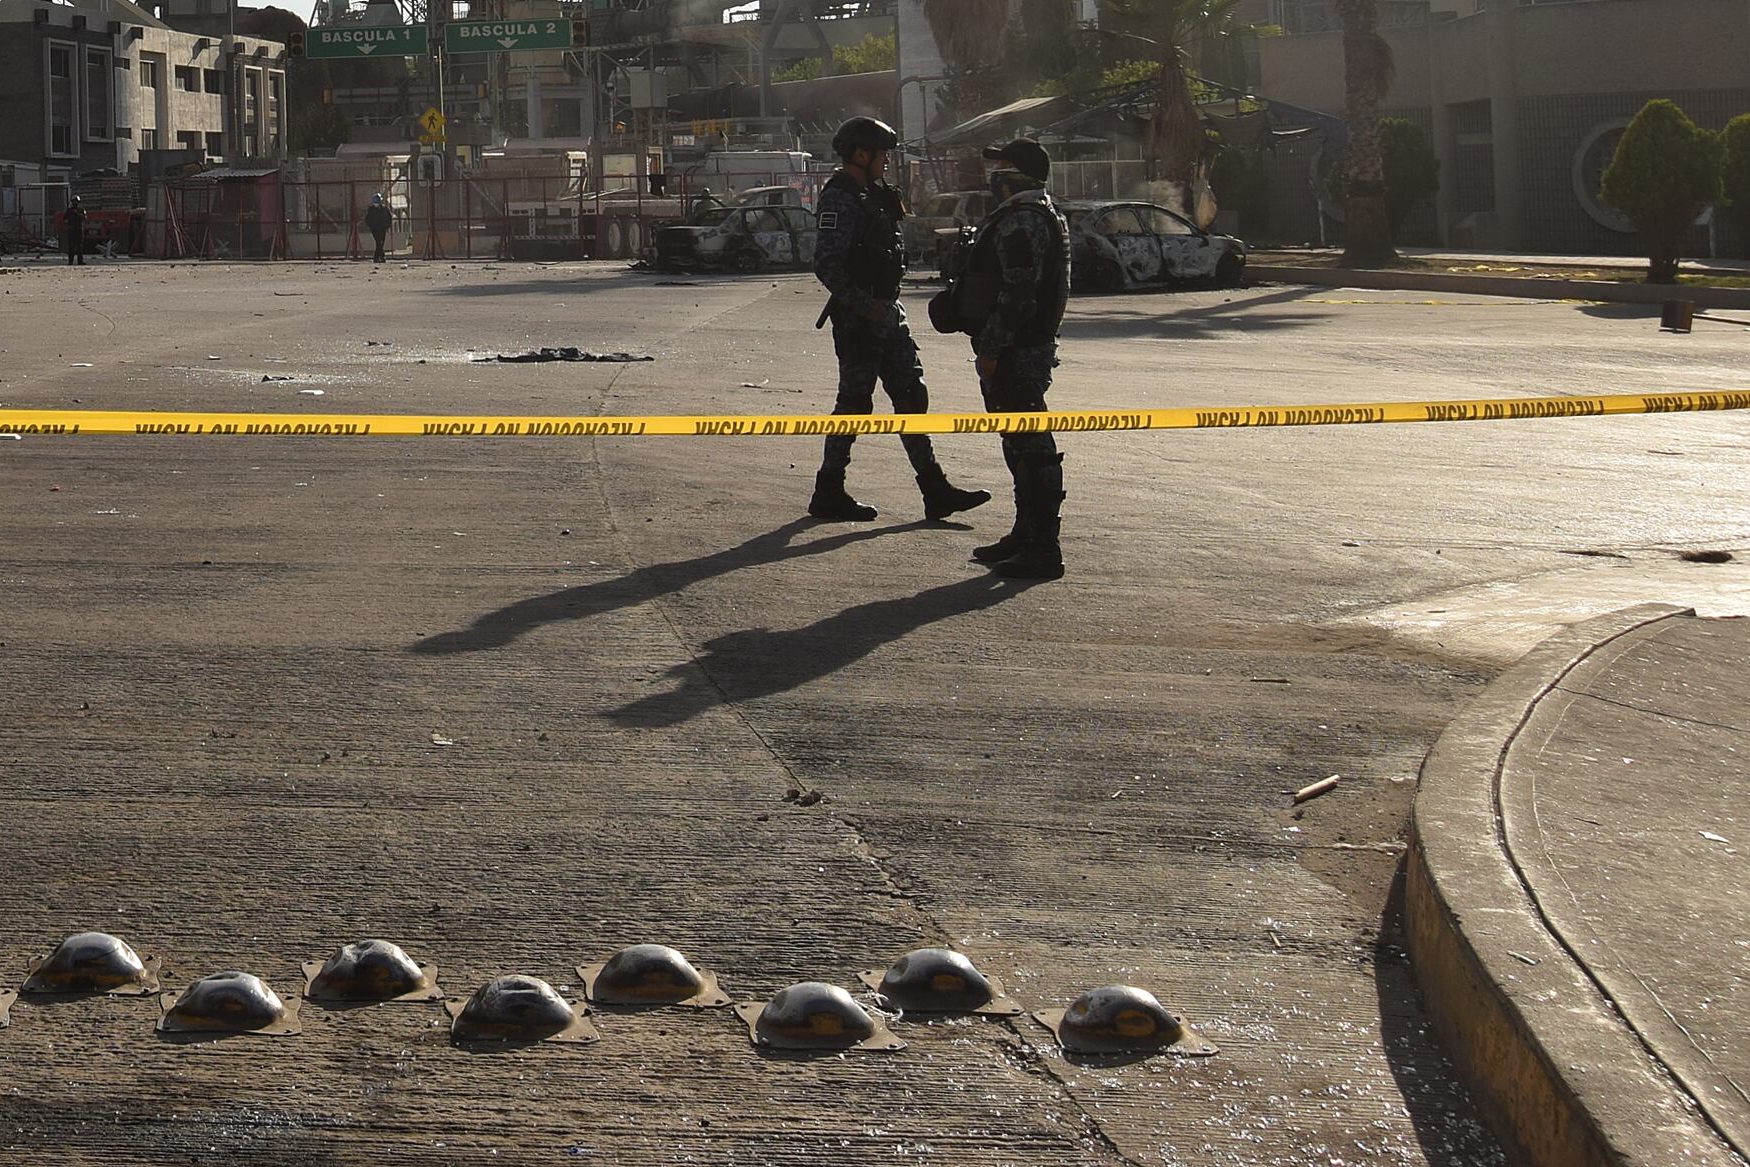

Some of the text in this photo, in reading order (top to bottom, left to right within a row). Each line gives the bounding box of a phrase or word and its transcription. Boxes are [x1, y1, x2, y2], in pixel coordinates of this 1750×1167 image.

[321, 28, 411, 43] BASCULA 1
[460, 22, 556, 38] BASCULA 2
